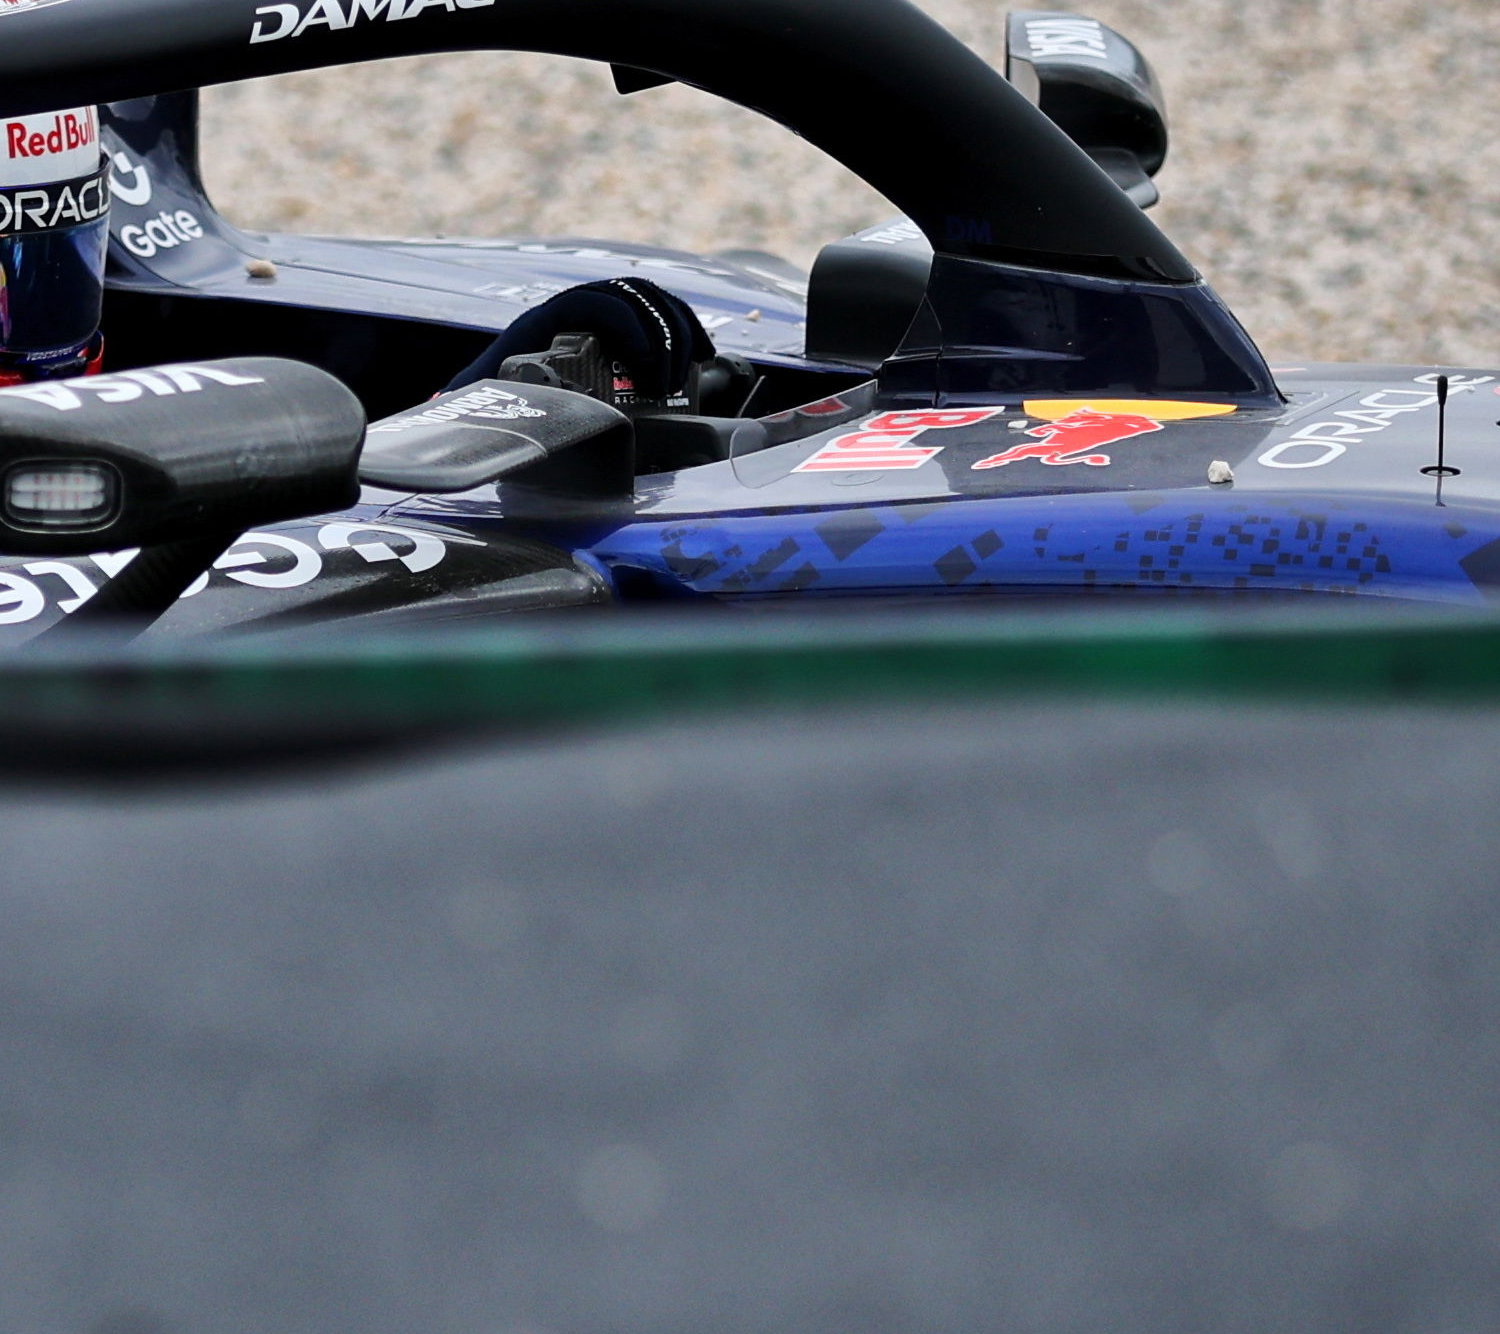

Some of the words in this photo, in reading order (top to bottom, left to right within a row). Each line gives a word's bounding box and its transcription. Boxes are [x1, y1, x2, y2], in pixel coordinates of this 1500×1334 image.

[6, 114, 63, 159] Red
[64, 105, 96, 150] Bull
[120, 209, 204, 257] Gate
[791, 406, 1006, 473] Bull
[1257, 373, 1496, 469] ORACLE
